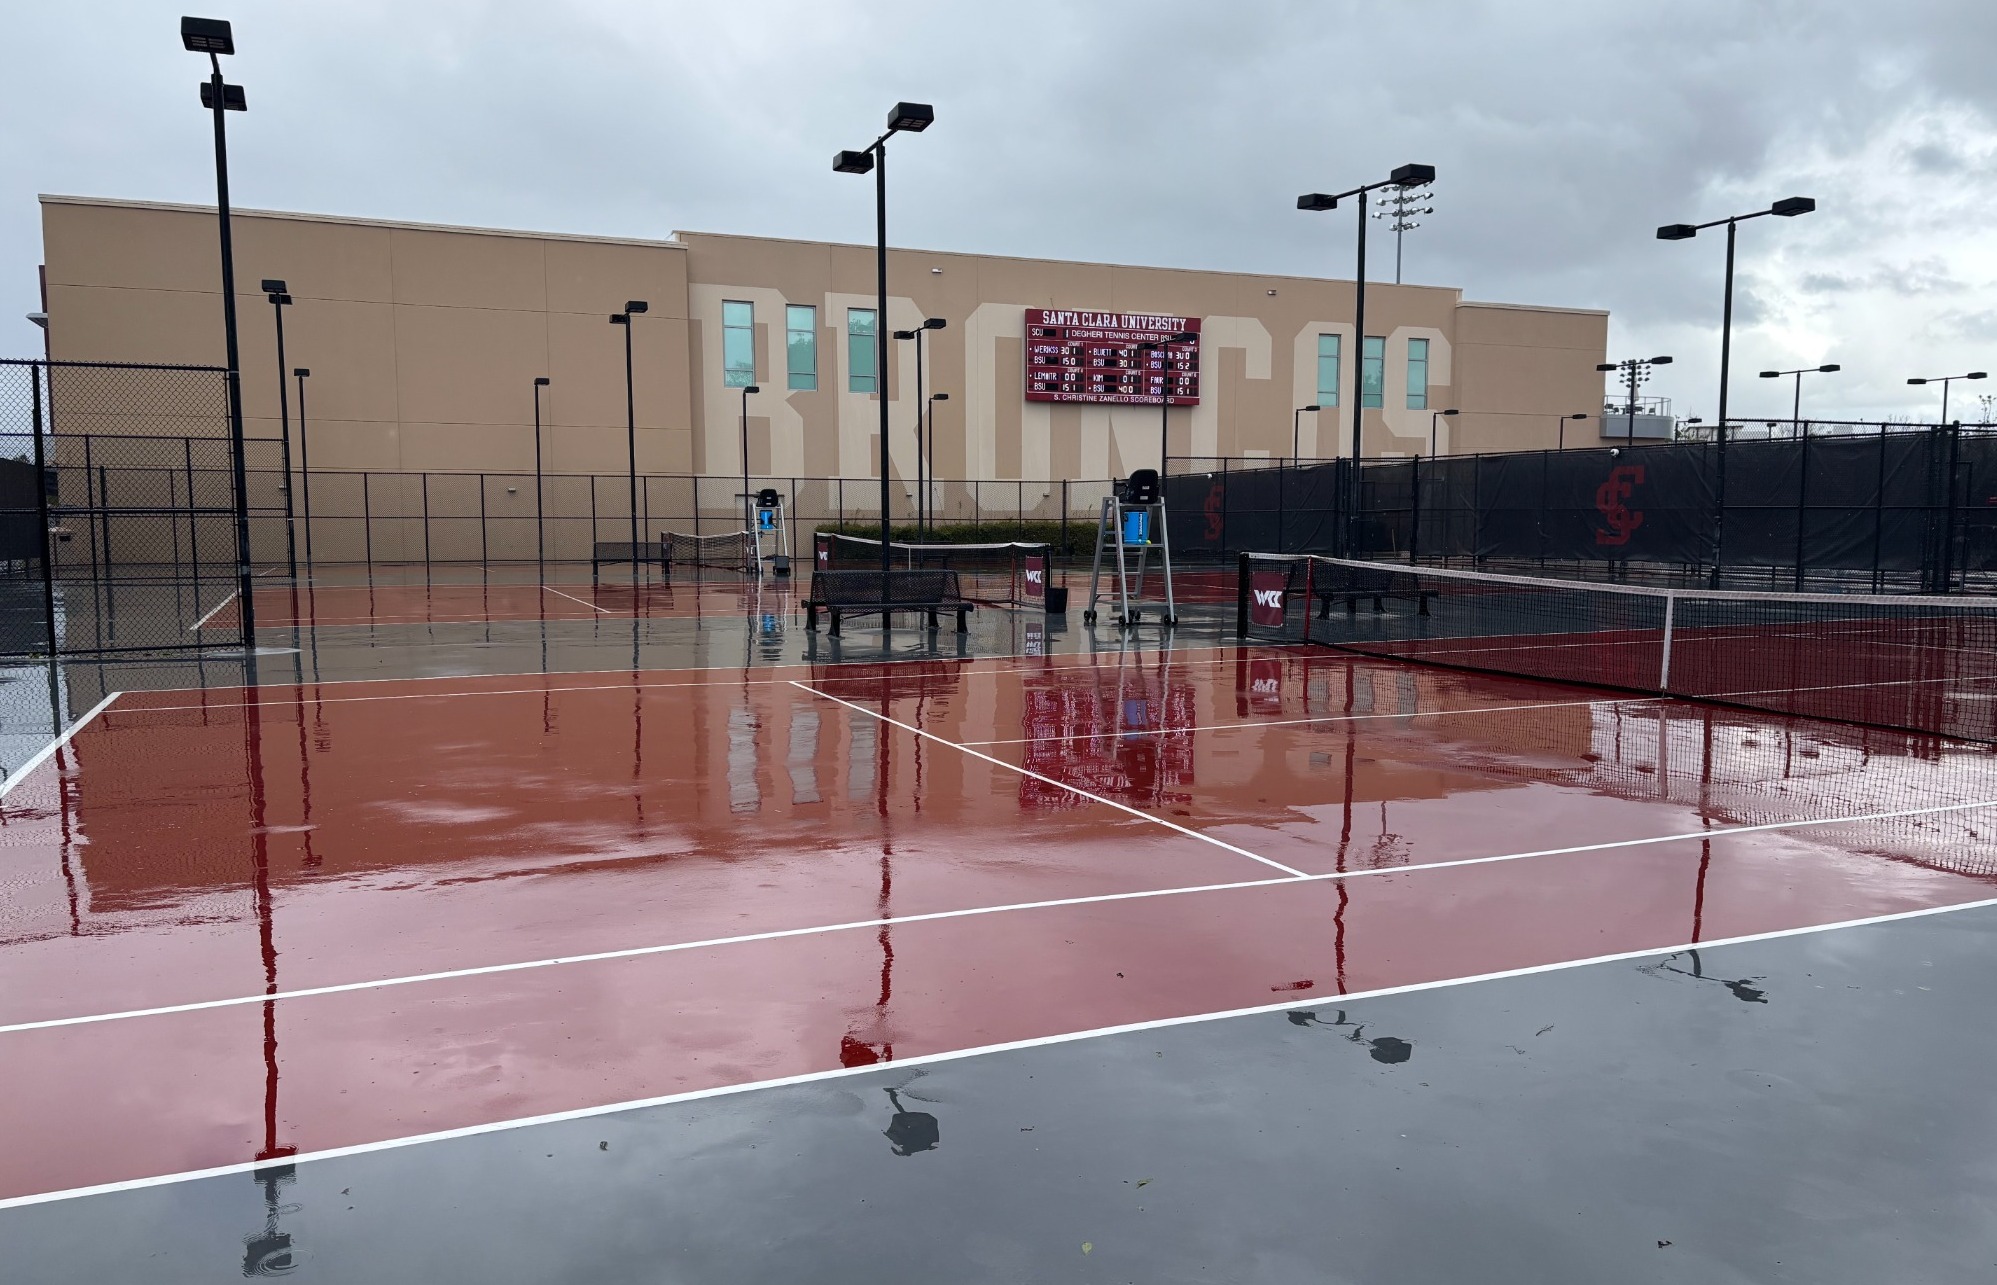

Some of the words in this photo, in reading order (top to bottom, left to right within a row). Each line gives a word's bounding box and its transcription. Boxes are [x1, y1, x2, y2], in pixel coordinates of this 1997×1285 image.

[1043, 310, 1079, 326] SANTA
[1082, 313, 1118, 328] CLARA
[1121, 315, 1186, 331] UNIVERSITY
[1032, 328, 1044, 336] SCU
[1072, 330, 1102, 338] DEGHERI
[1104, 332, 1130, 340] TENNIS
[1061, 346, 1070, 354] 30
[1034, 356, 1046, 364] BSU
[1070, 358, 1076, 366] 0
[1094, 358, 1104, 366] BSU
[1120, 360, 1128, 368] 30
[1064, 373, 1070, 381] 0
[1034, 382, 1046, 390] BSU
[688, 283, 1452, 511] BRONCOS
[1026, 569, 1042, 584] WCC
[1254, 590, 1282, 608] WCC
